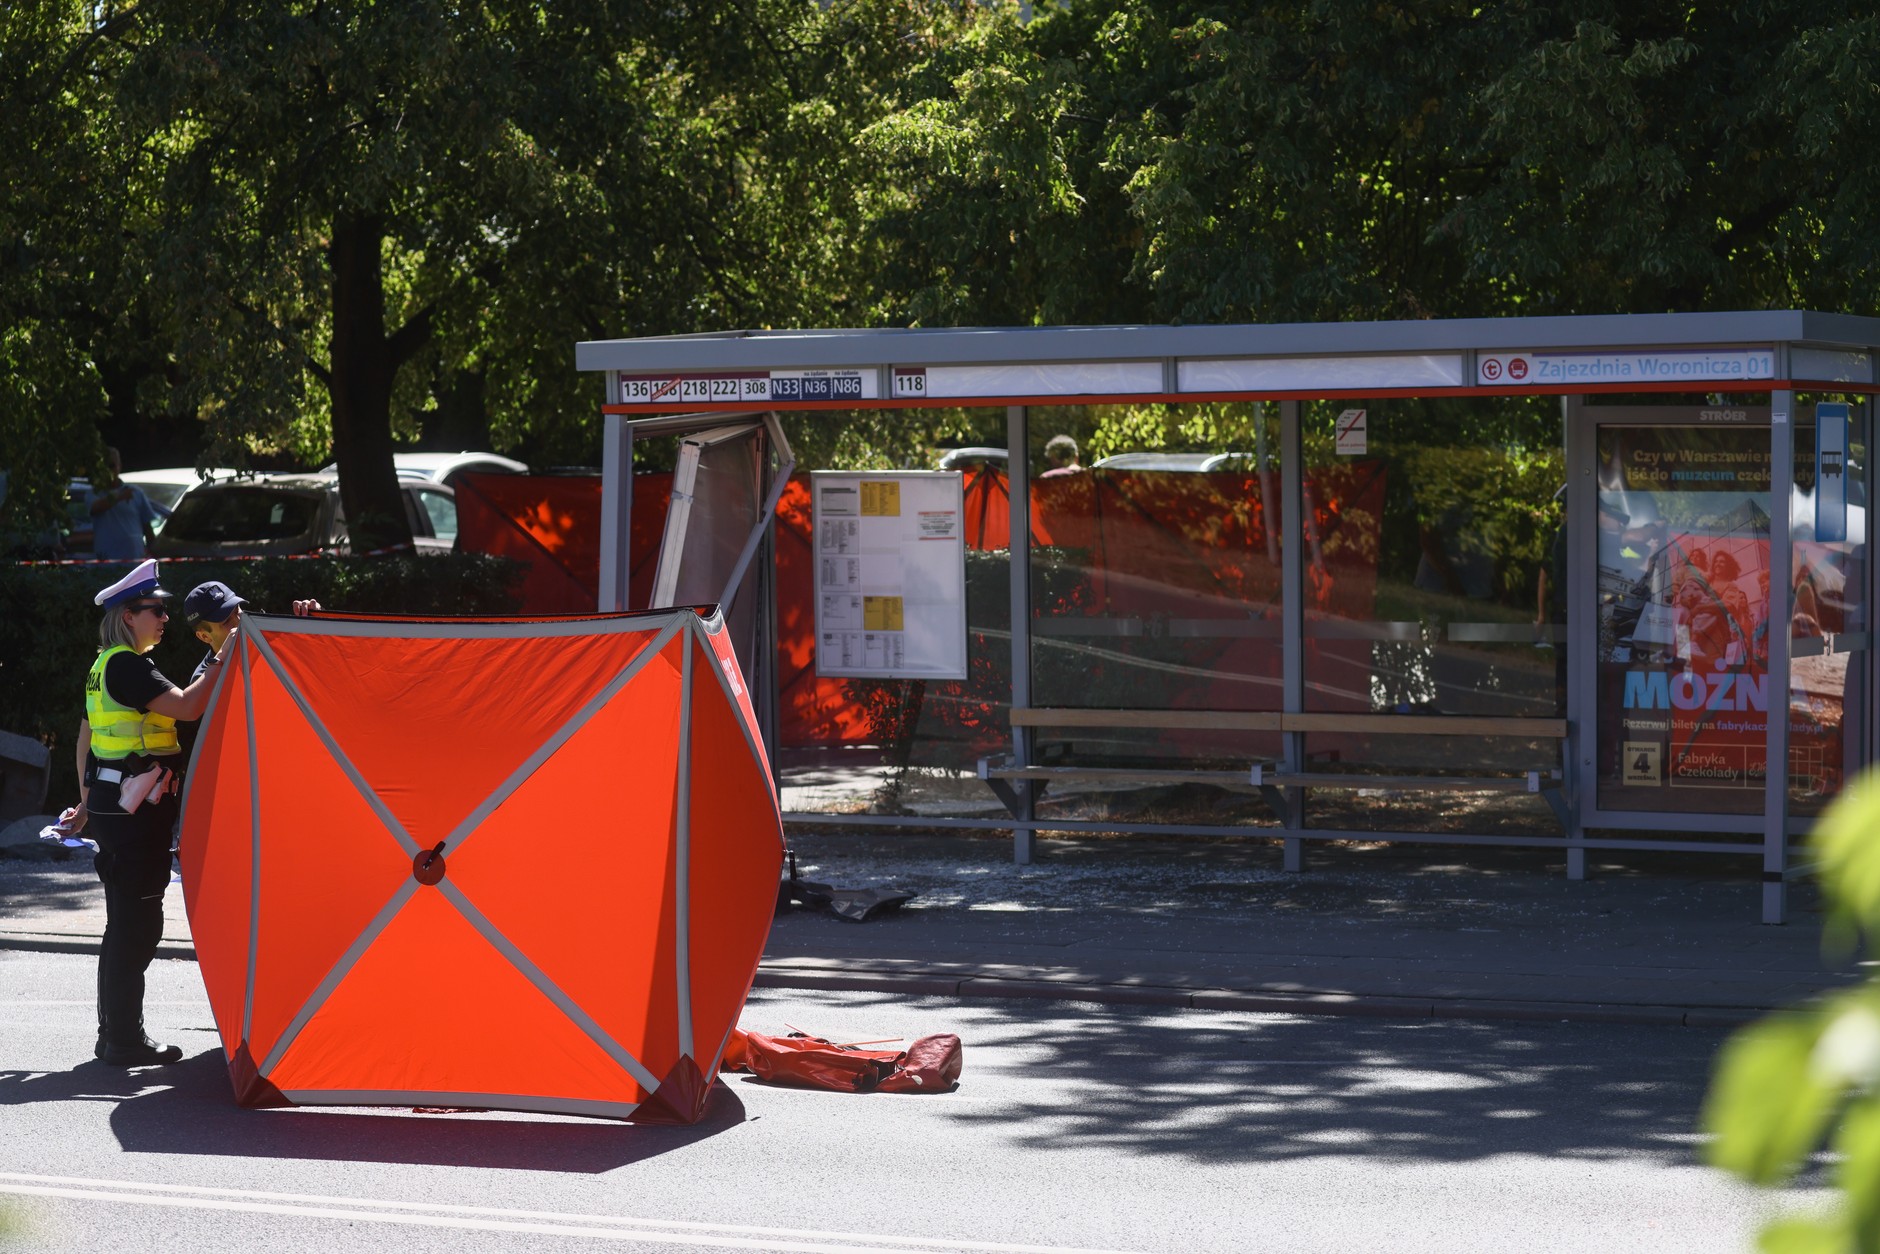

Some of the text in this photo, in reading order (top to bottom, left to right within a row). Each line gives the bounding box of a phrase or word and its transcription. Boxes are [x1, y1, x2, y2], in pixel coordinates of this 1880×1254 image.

[1538, 356, 1769, 380] Zajezdnia Woronicza 01
[624, 382, 648, 397] 136
[683, 381, 708, 396] 218
[713, 380, 737, 395] 222
[744, 381, 767, 394] 308
[772, 379, 799, 395] N33
[804, 380, 827, 393] N36
[833, 378, 860, 394] N86
[898, 376, 923, 391] 118
[1633, 449, 1660, 466] Czy
[1662, 453, 1677, 462] w
[1679, 449, 1761, 463] Warszawie
[1650, 467, 1669, 481] do
[1671, 471, 1735, 481] muzeum
[1622, 718, 1670, 732] Rezerwuj
[1671, 718, 1700, 732] bilety
[1702, 722, 1715, 731] na
[1632, 752, 1651, 774] 4
[1678, 752, 1726, 767] Fabryka
[1678, 765, 1739, 782] Czekolady
